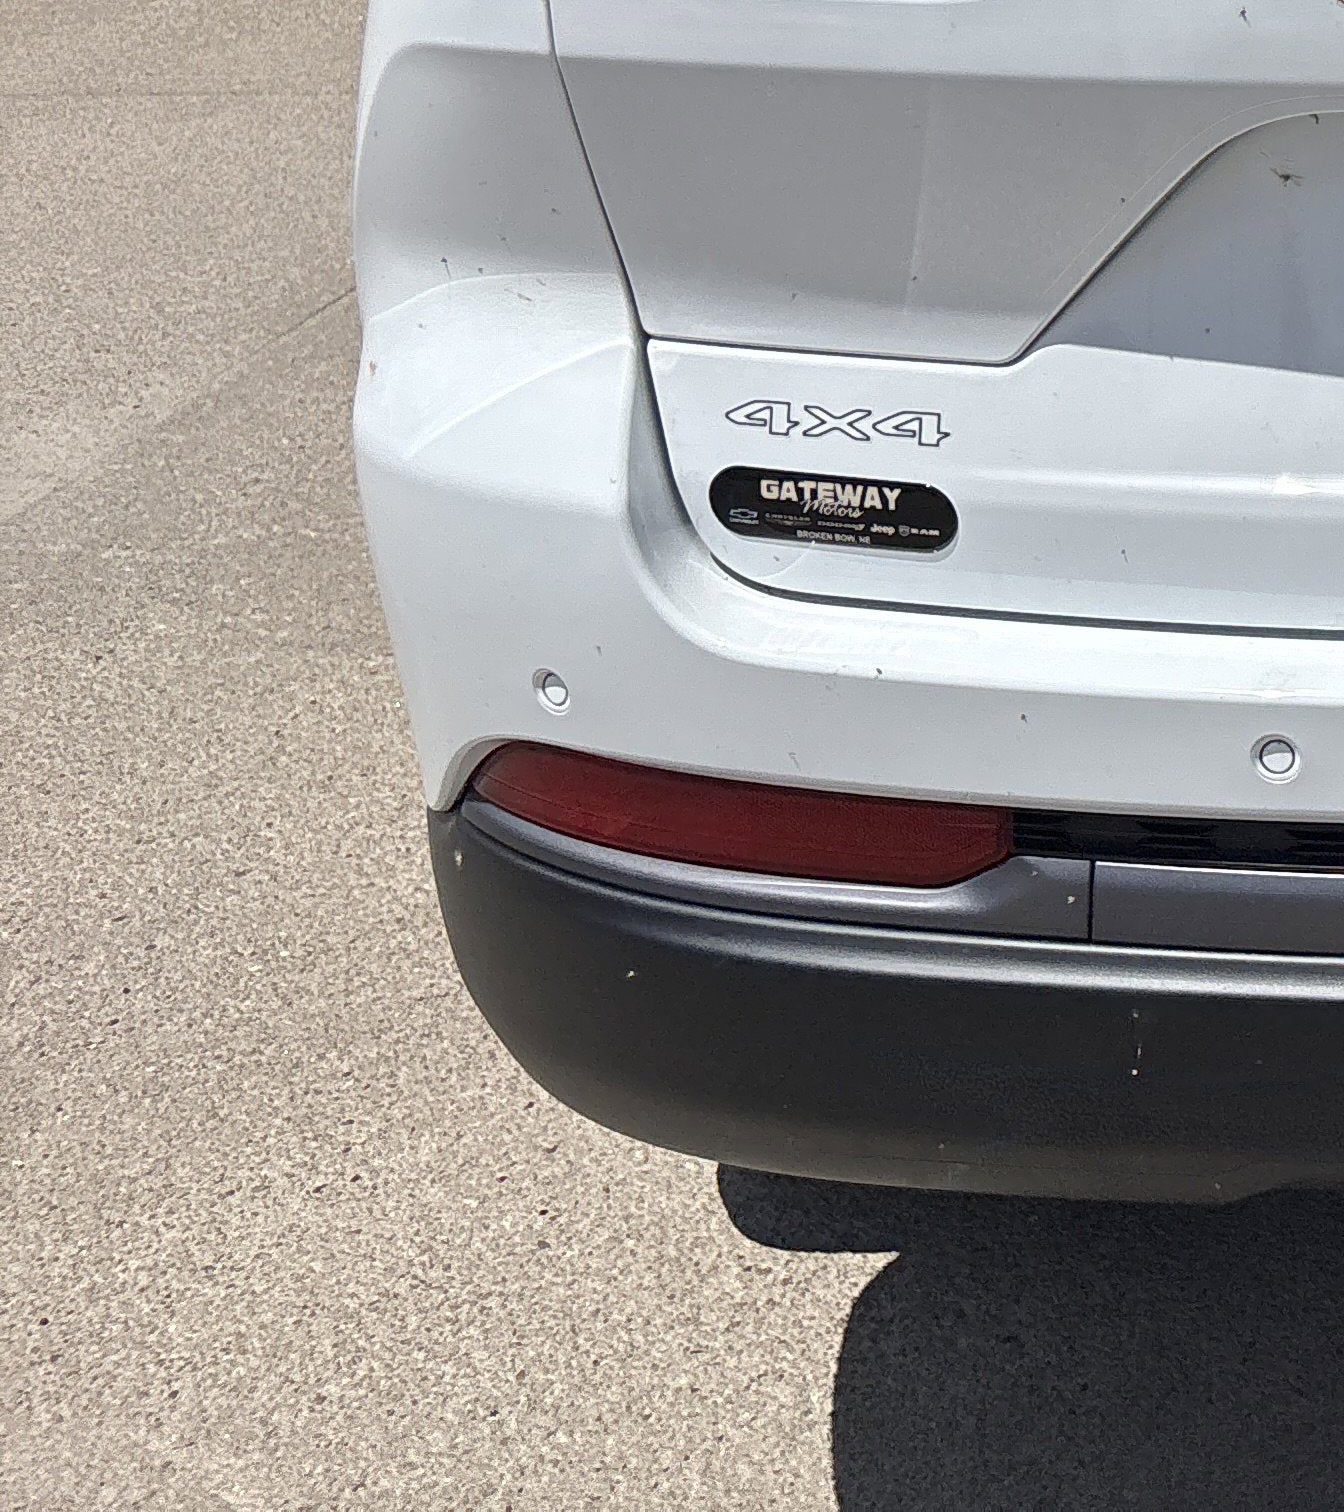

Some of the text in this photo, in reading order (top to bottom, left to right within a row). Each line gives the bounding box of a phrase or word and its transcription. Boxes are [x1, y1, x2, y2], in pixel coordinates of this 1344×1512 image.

[760, 479, 902, 511] GATEWAY
[800, 498, 865, 519] Motors
[796, 529, 833, 541] BROKEN
[870, 523, 896, 536] Jeep
